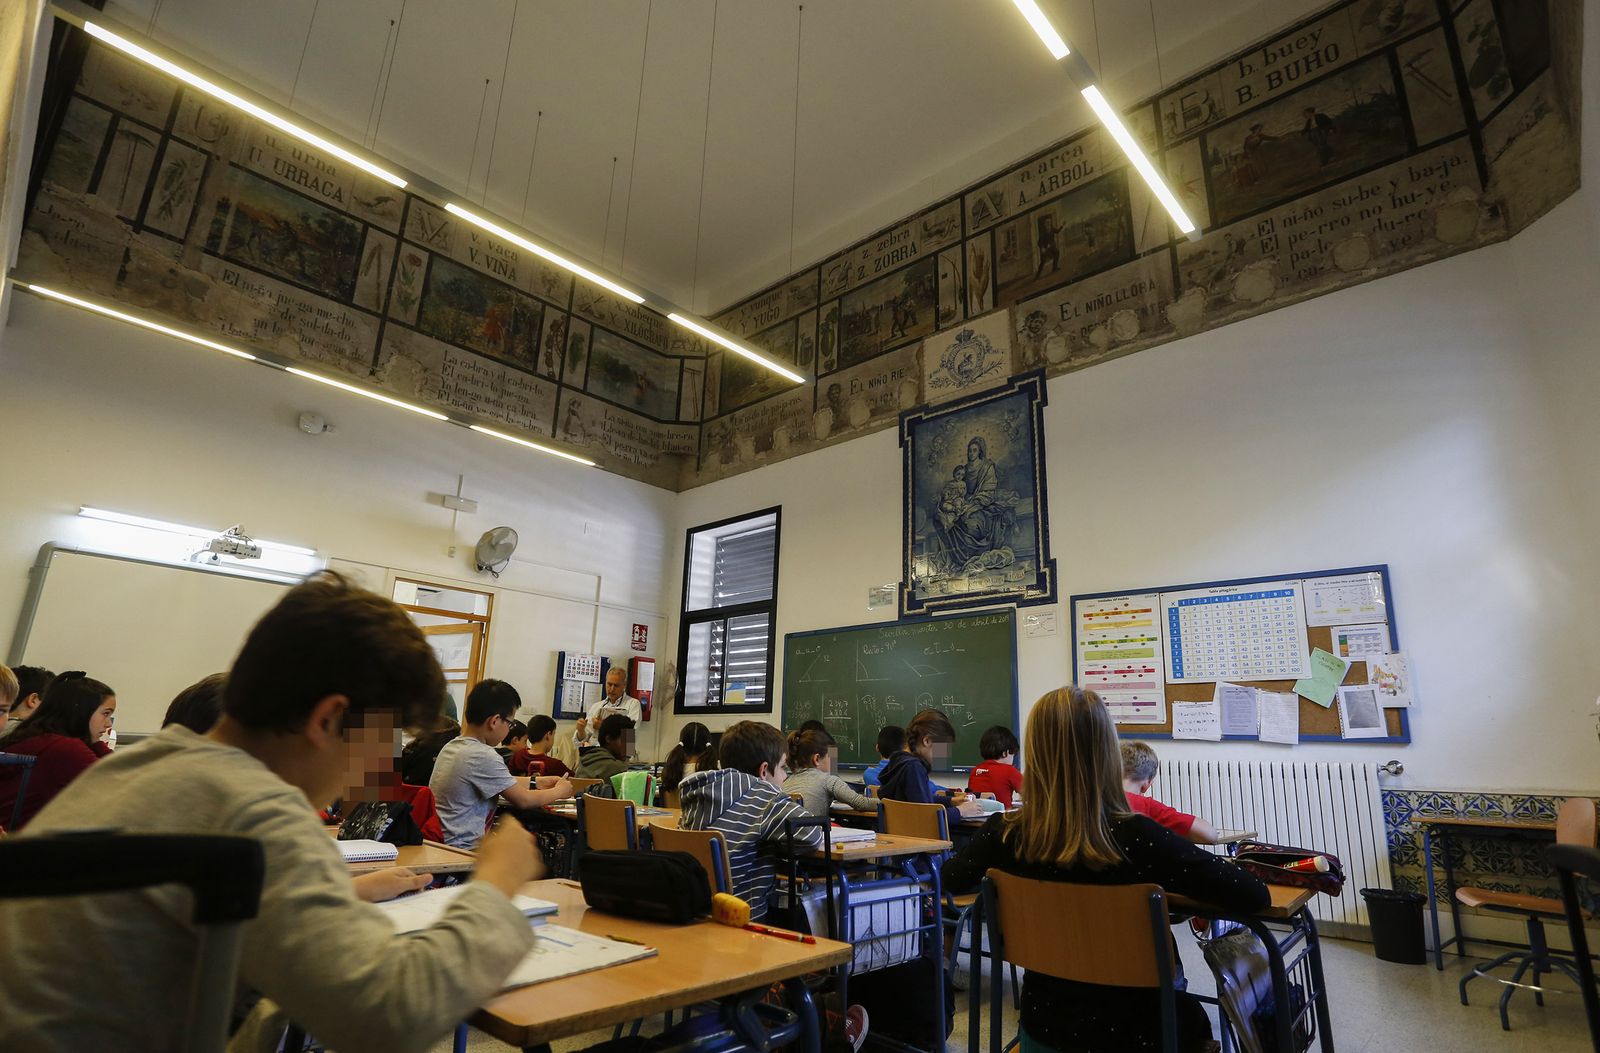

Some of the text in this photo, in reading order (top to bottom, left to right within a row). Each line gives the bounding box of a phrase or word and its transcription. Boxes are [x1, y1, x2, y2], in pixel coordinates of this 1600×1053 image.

[1262, 27, 1325, 67] buey
[1037, 144, 1084, 175] arca
[273, 157, 344, 204] URRACA
[1038, 158, 1095, 198] ÁRBOL
[1257, 217, 1275, 237] El
[1331, 184, 1381, 211] su-be
[1388, 175, 1400, 197] y
[1408, 155, 1468, 182] ba-ja.
[876, 228, 911, 252] zebra
[1259, 233, 1279, 255] El
[1287, 213, 1351, 251] pe-rro
[1359, 205, 1383, 222] no
[487, 240, 518, 262] vaca
[873, 240, 918, 274] ZORRA
[223, 268, 240, 287] El
[485, 254, 517, 282] VIÑA
[753, 306, 780, 329] YUGO
[441, 362, 455, 377] El
